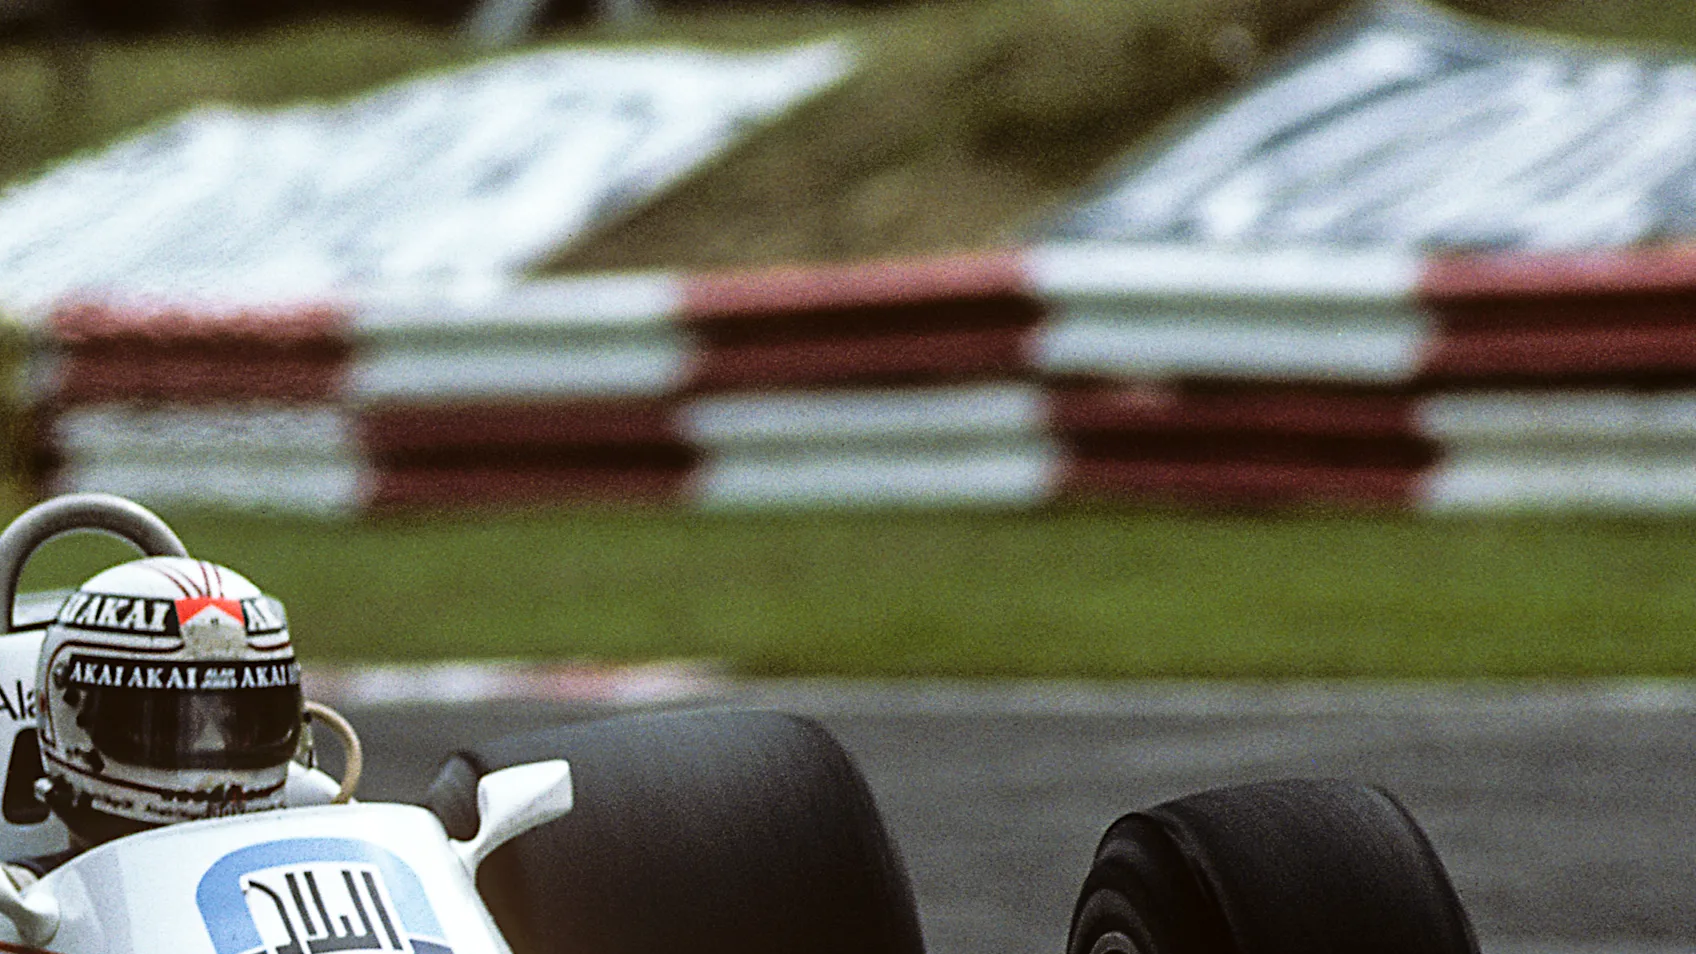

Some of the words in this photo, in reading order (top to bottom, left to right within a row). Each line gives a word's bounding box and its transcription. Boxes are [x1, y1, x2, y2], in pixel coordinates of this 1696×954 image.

[76, 594, 172, 633] AKAI
[69, 660, 124, 687] AKAI
[127, 665, 198, 690] AKAI
[240, 663, 287, 689] AKAI
